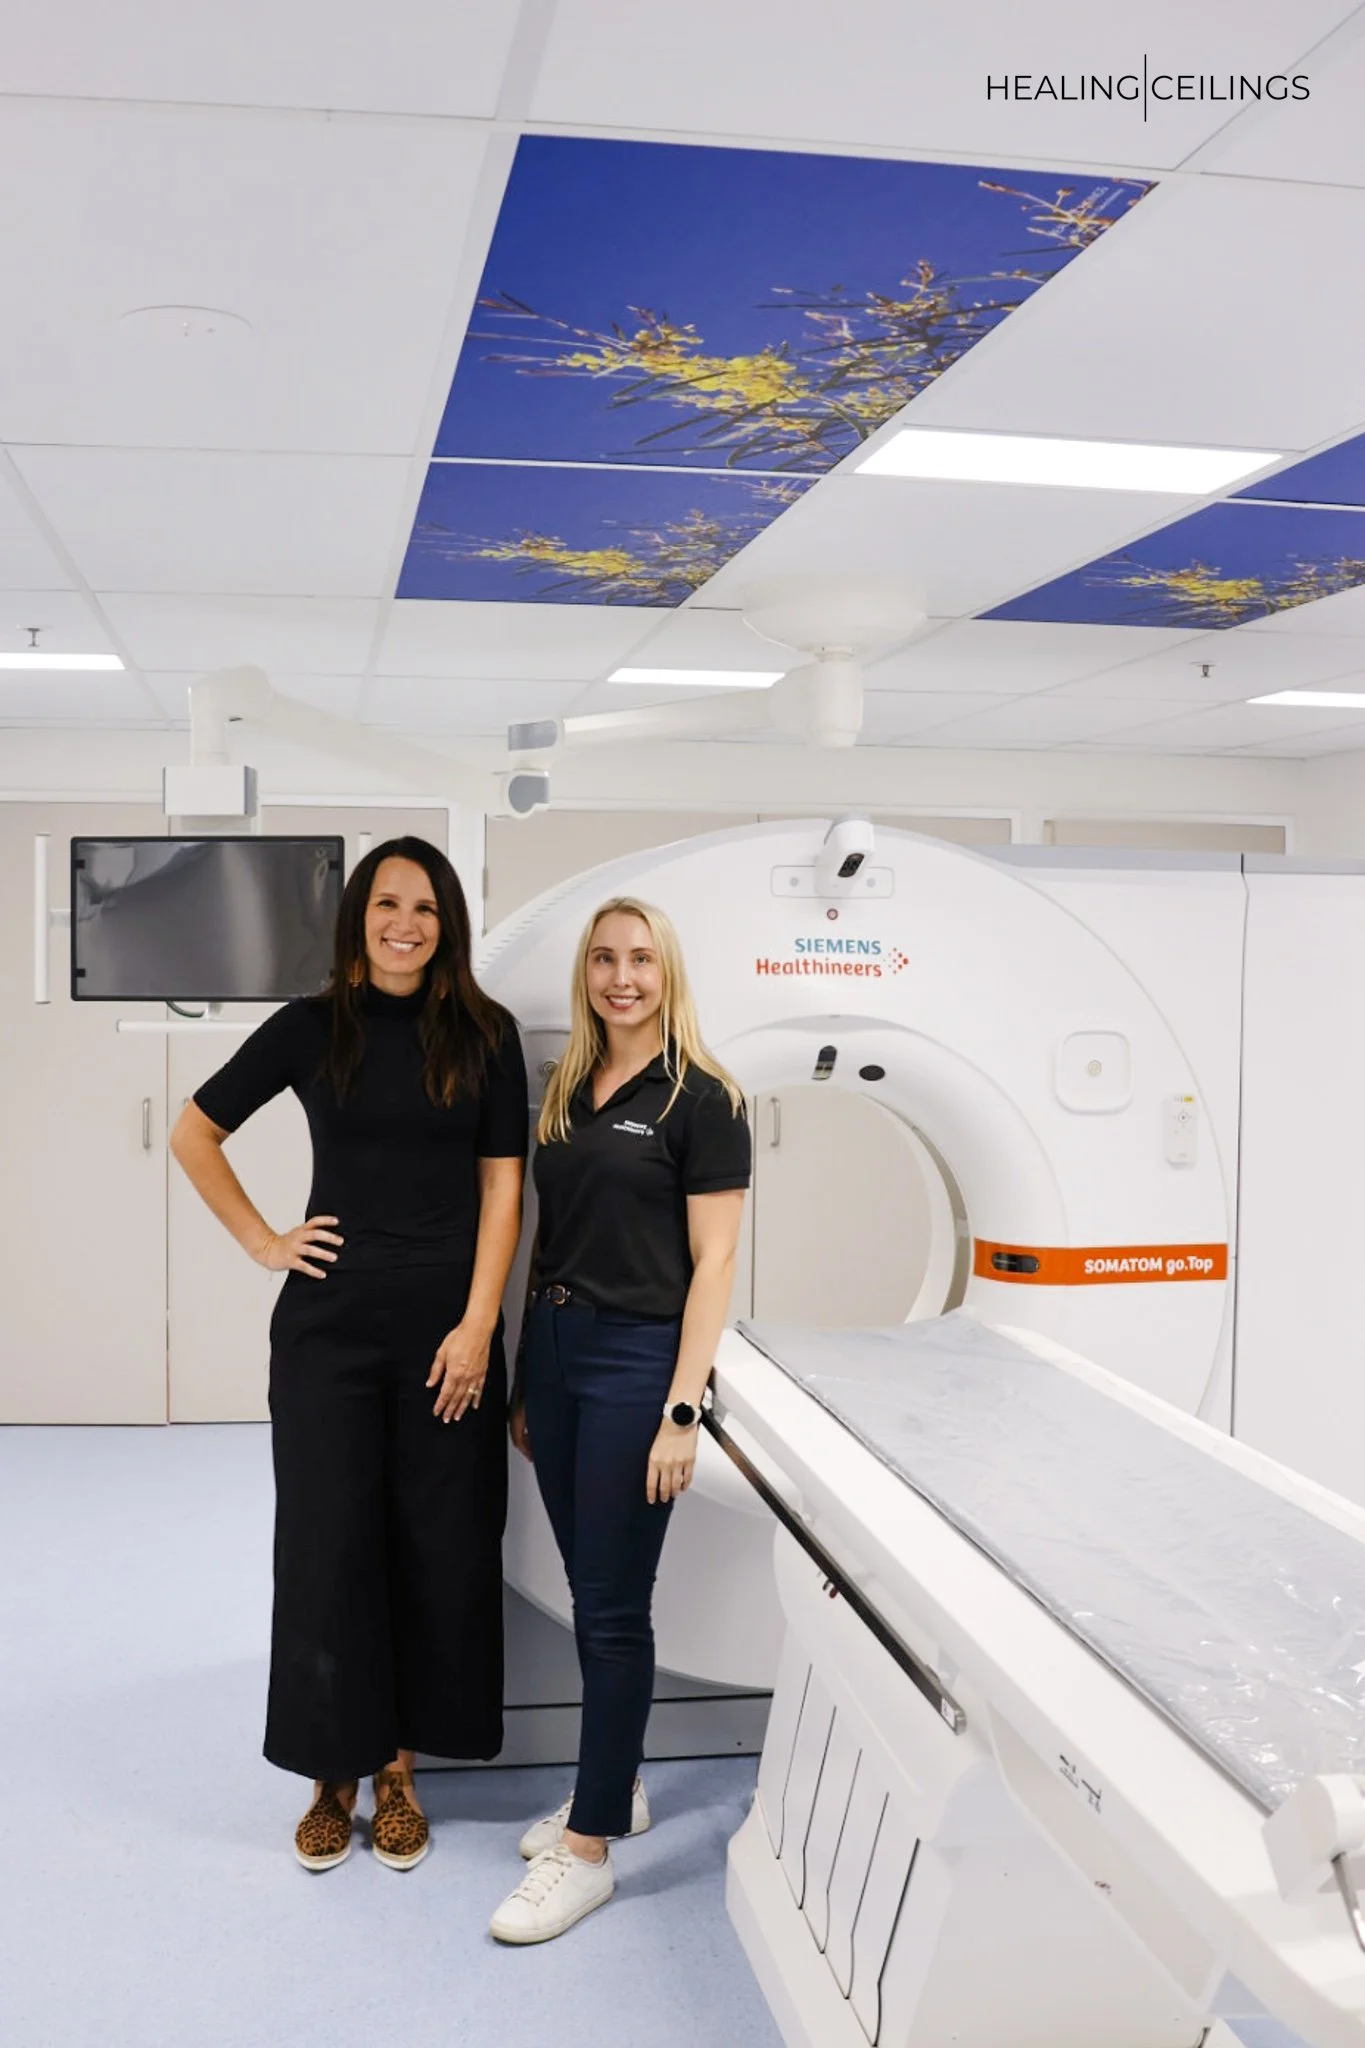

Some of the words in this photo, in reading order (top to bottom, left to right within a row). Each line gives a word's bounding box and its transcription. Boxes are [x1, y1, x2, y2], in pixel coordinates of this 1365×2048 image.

[794, 937, 882, 955] SIEMENS
[755, 958, 883, 978] Healthineers
[1084, 1257, 1162, 1274] SOMATOM
[1166, 1255, 1214, 1275] go.Top
